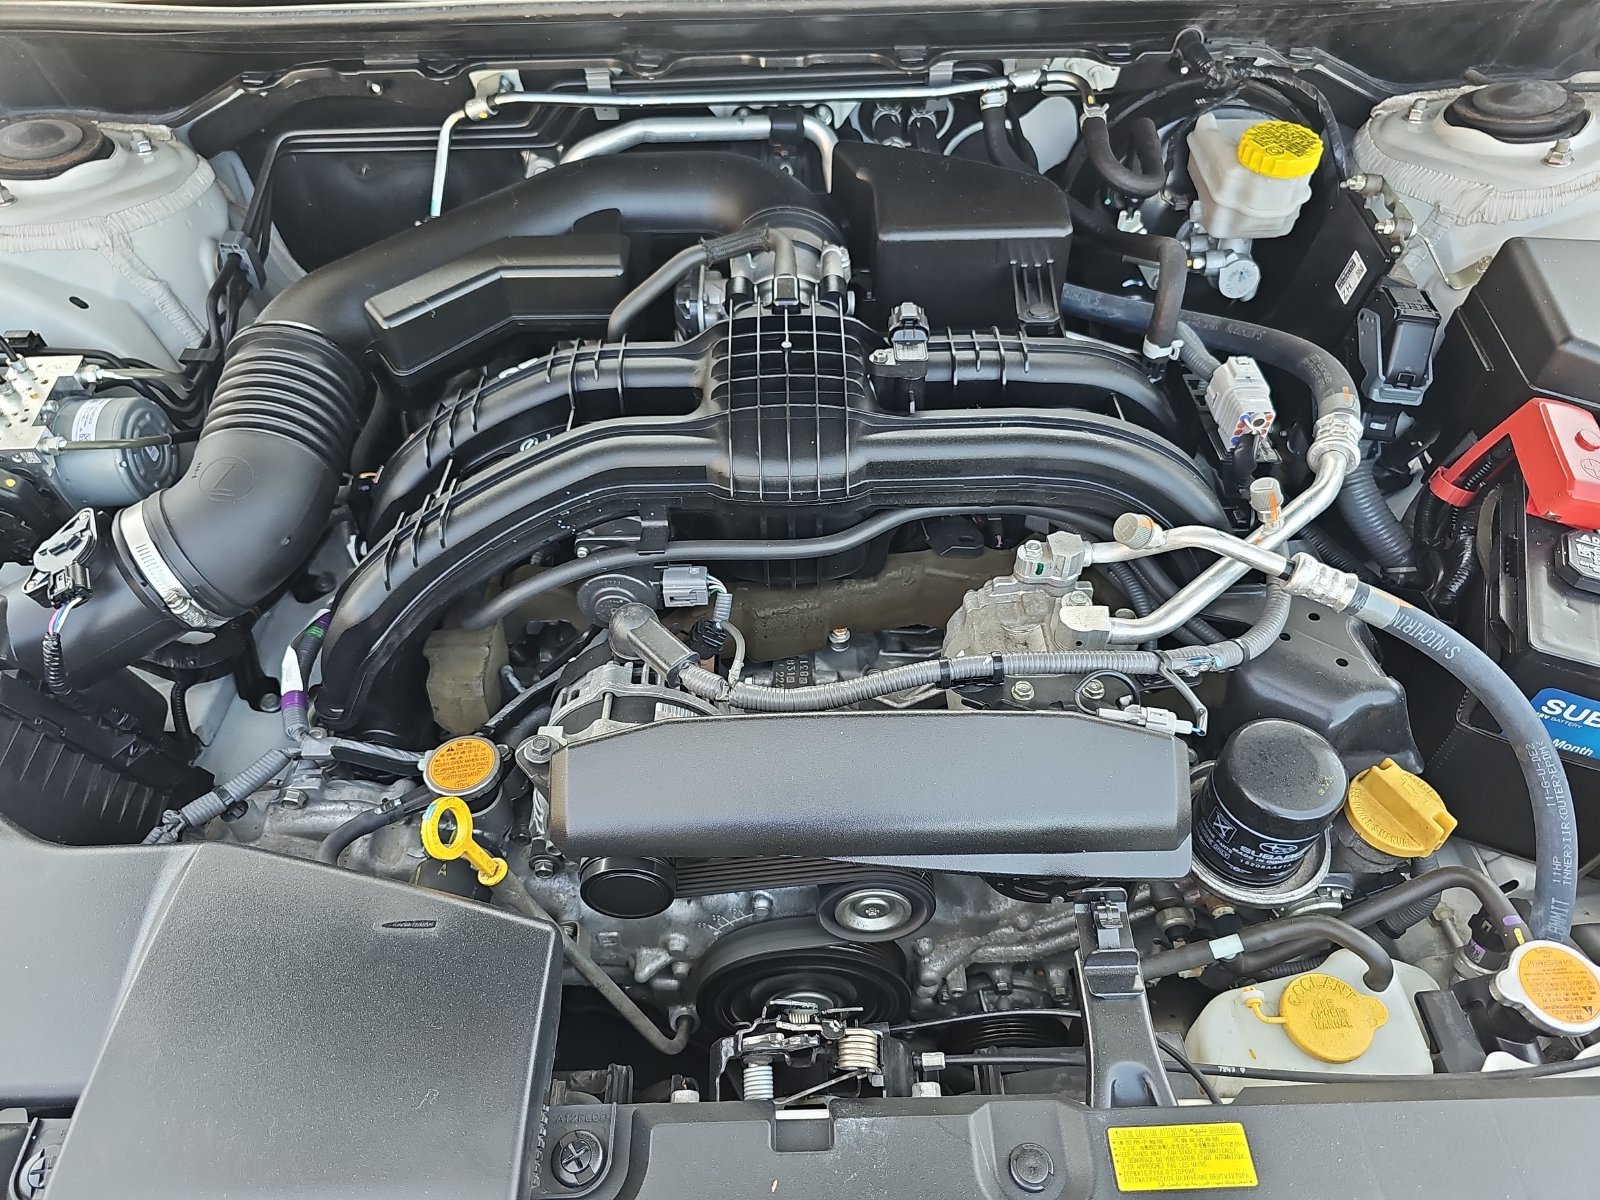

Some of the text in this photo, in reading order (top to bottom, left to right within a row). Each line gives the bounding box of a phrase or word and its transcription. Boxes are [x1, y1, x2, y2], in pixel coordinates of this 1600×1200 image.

[1550, 716, 1583, 729] BATTERY
[1553, 738, 1594, 757] Month
[1288, 975, 1359, 1005] COOLANT
[1314, 1018, 1353, 1030] MANUAL
